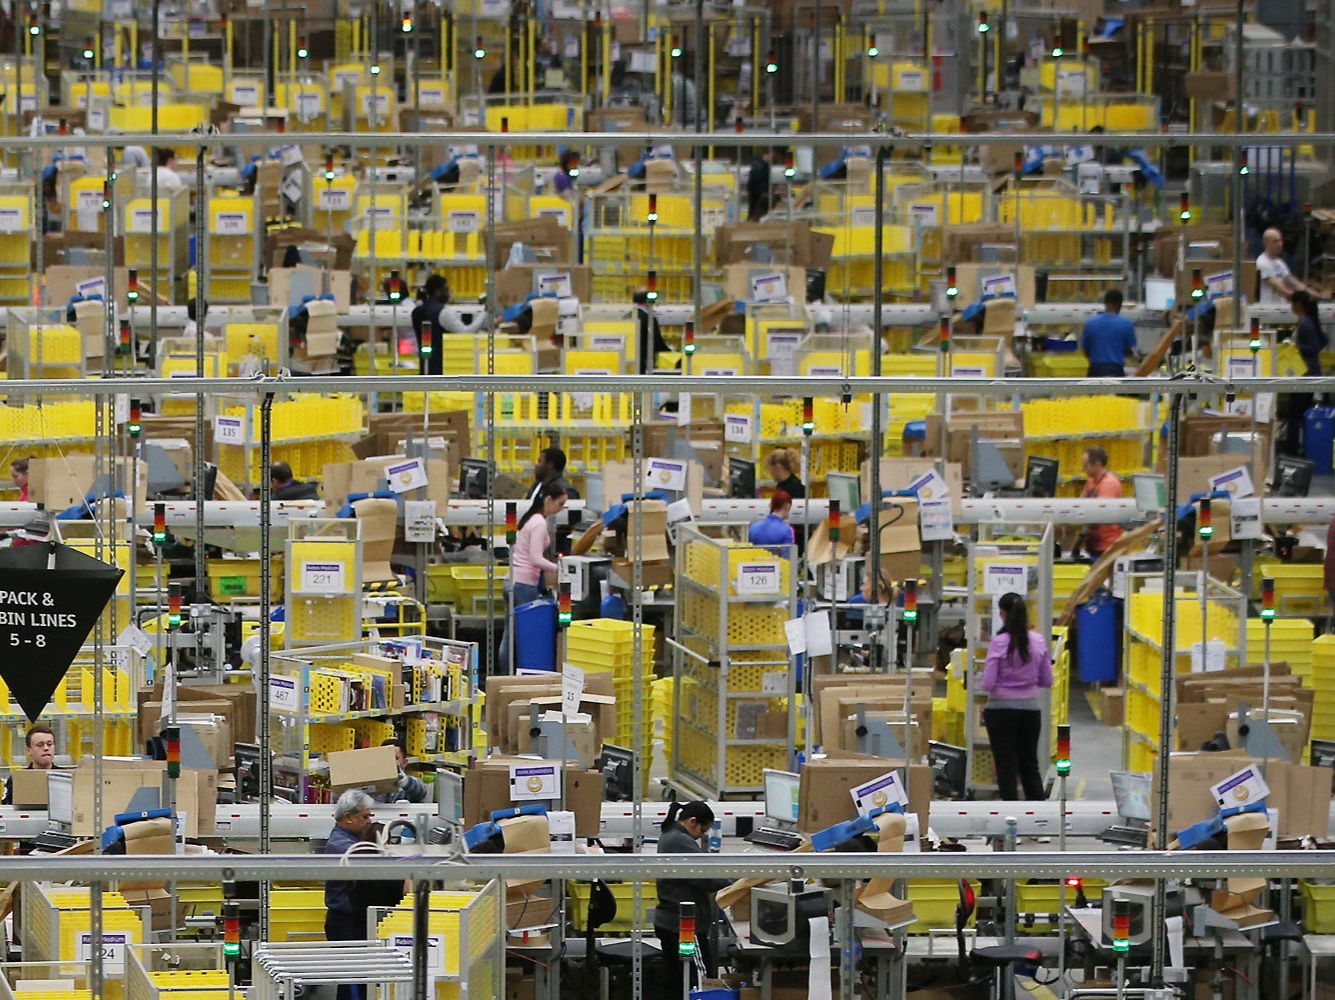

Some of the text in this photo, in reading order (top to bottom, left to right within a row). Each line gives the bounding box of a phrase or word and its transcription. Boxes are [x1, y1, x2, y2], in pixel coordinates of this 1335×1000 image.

[751, 576, 767, 585] 126
[0, 590, 54, 606] PACK &
[31, 613, 77, 628] LINES
[10, 633, 20, 646] 5
[35, 634, 46, 648] 8
